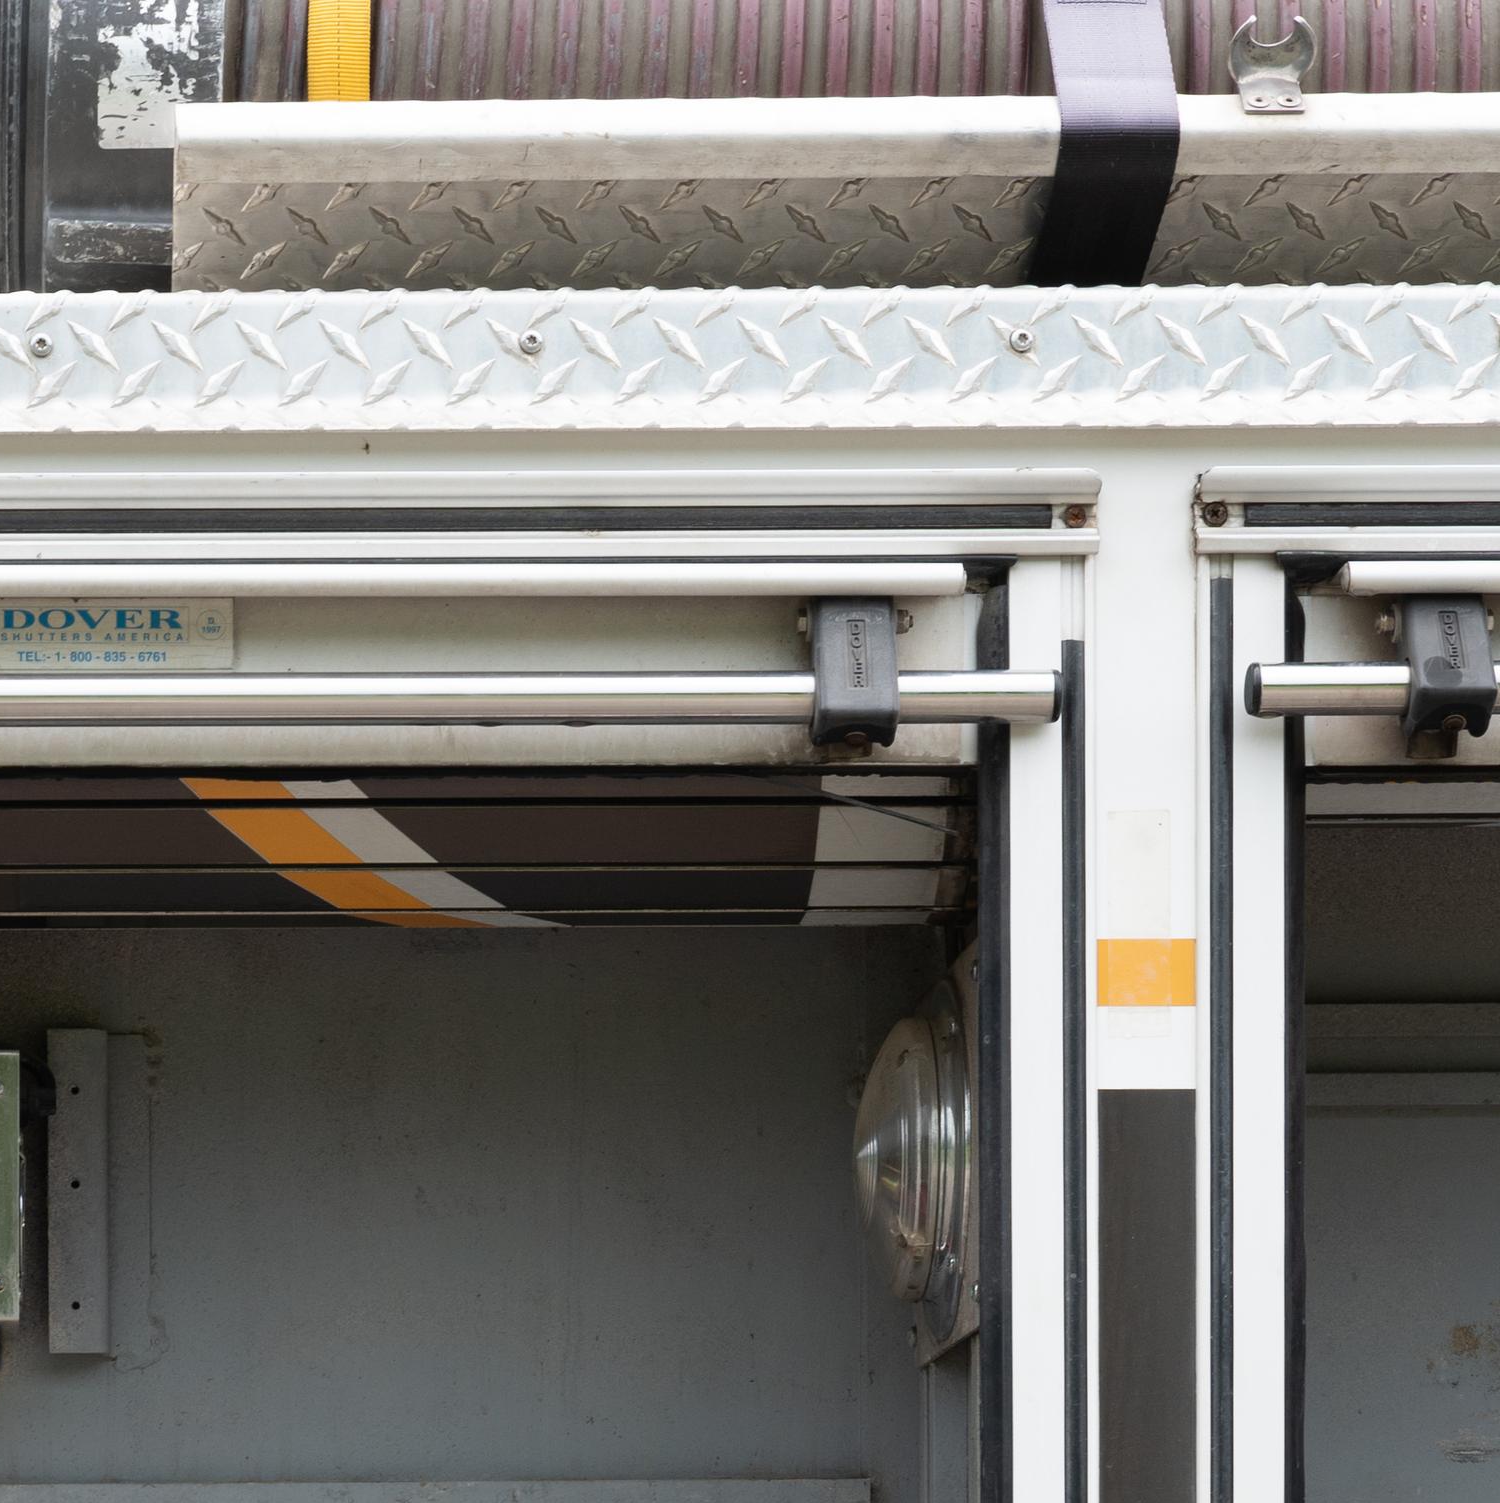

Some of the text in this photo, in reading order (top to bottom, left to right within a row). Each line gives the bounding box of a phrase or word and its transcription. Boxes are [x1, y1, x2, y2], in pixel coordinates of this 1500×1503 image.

[2, 609, 183, 629] DOVER
[1, 632, 184, 642] SHUTTERS AMERICA
[138, 651, 167, 662] 6761
